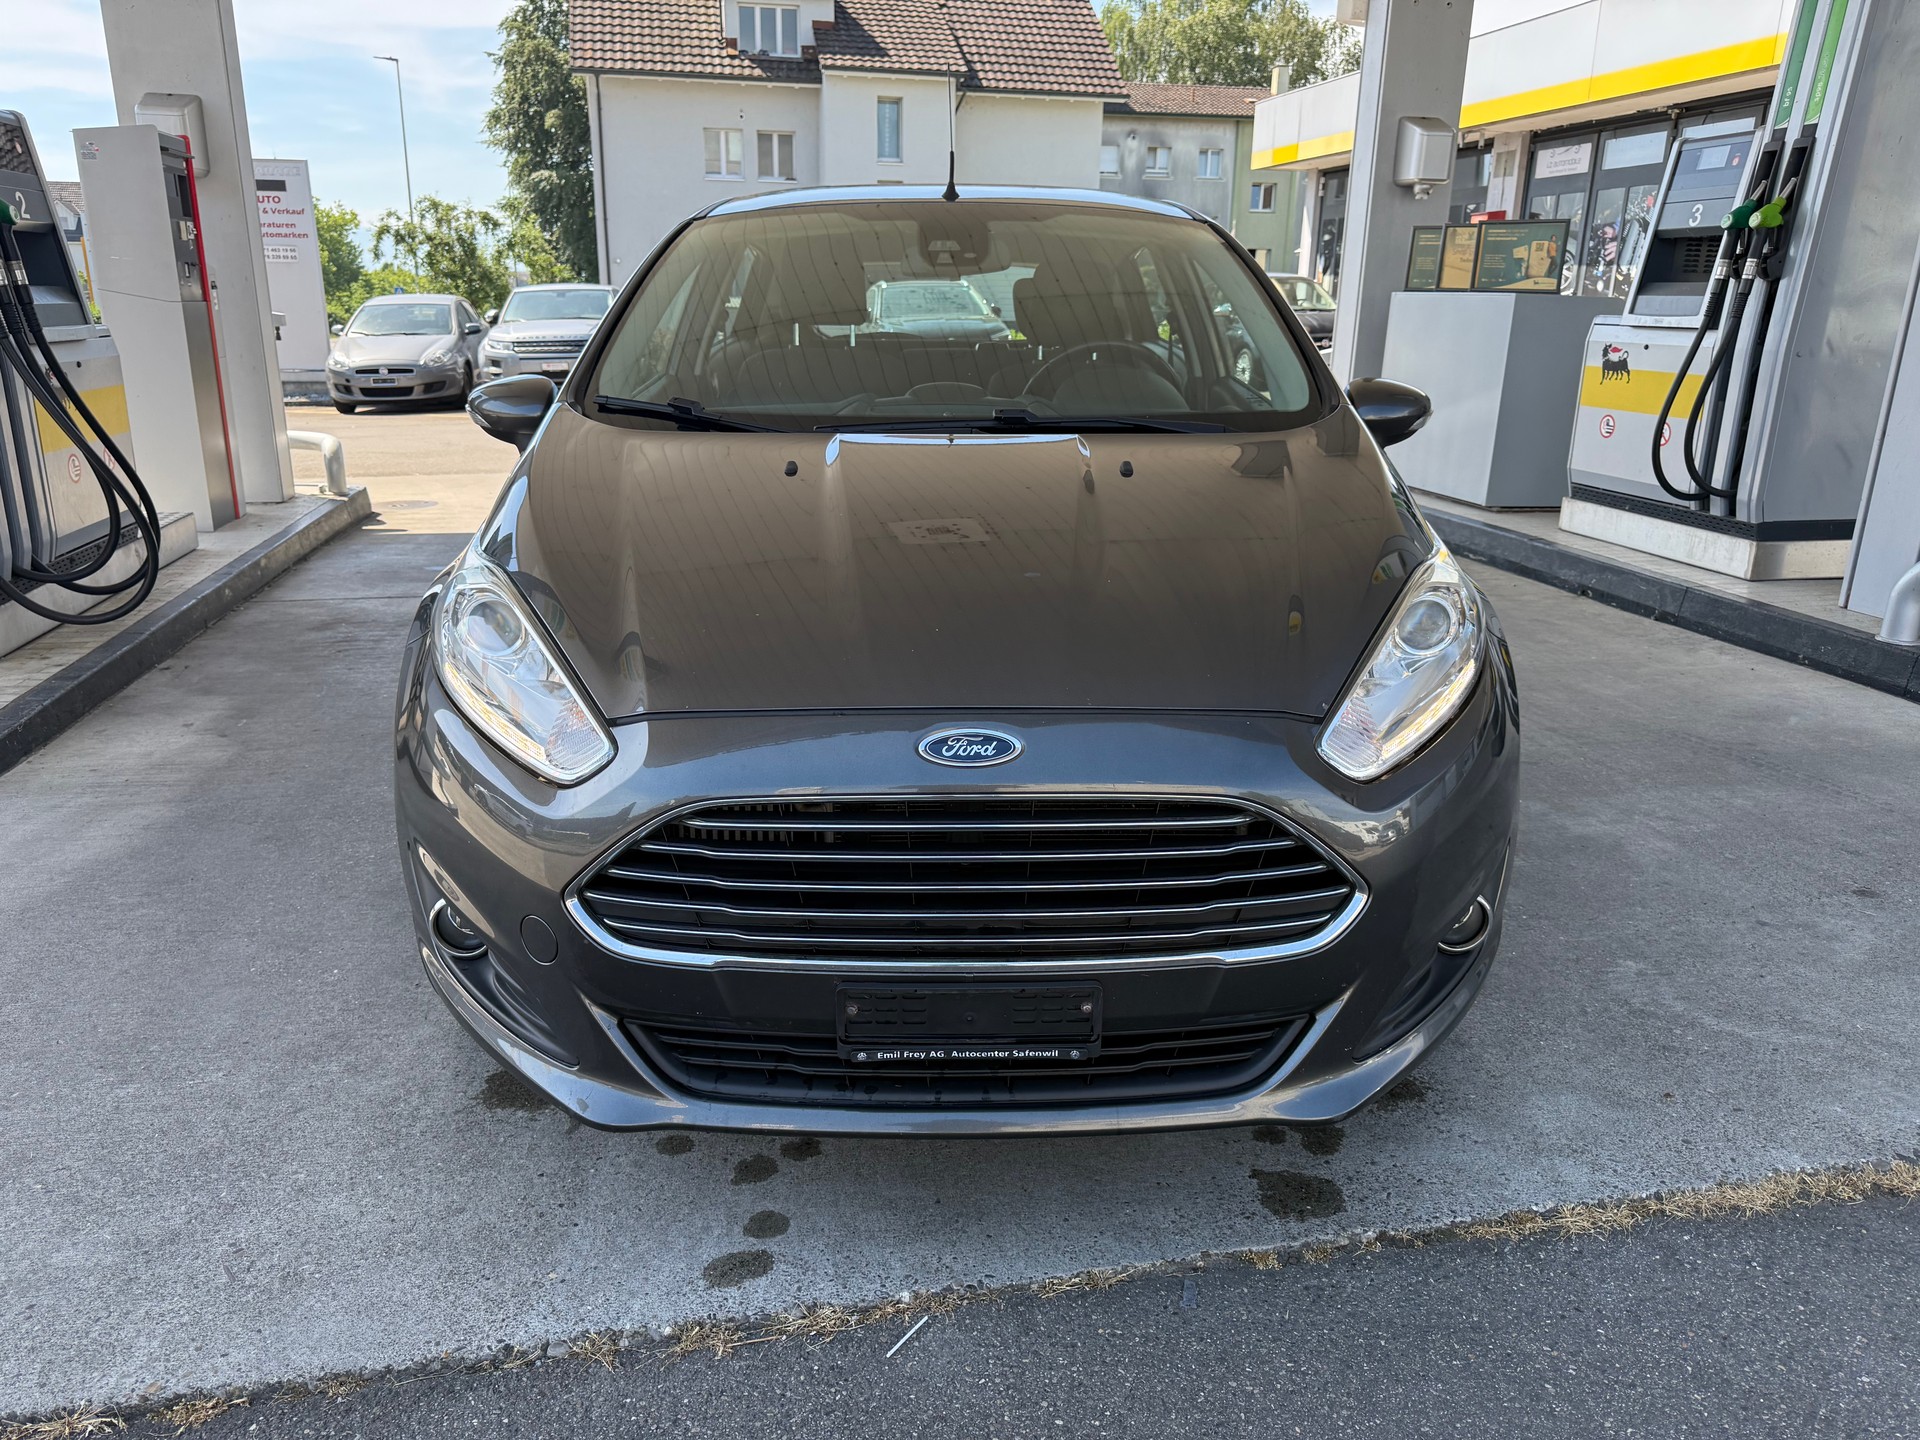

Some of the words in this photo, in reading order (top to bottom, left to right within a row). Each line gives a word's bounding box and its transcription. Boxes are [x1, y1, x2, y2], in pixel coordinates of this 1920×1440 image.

[15, 191, 31, 219] 2
[257, 195, 281, 204] UTO
[1688, 203, 1704, 227] 3
[942, 735, 997, 758] Ford
[877, 1051, 901, 1060] Emil
[903, 1050, 926, 1061] Frey
[951, 1050, 1009, 1060] Autocenter
[1012, 1049, 1059, 1059] Safenwil
